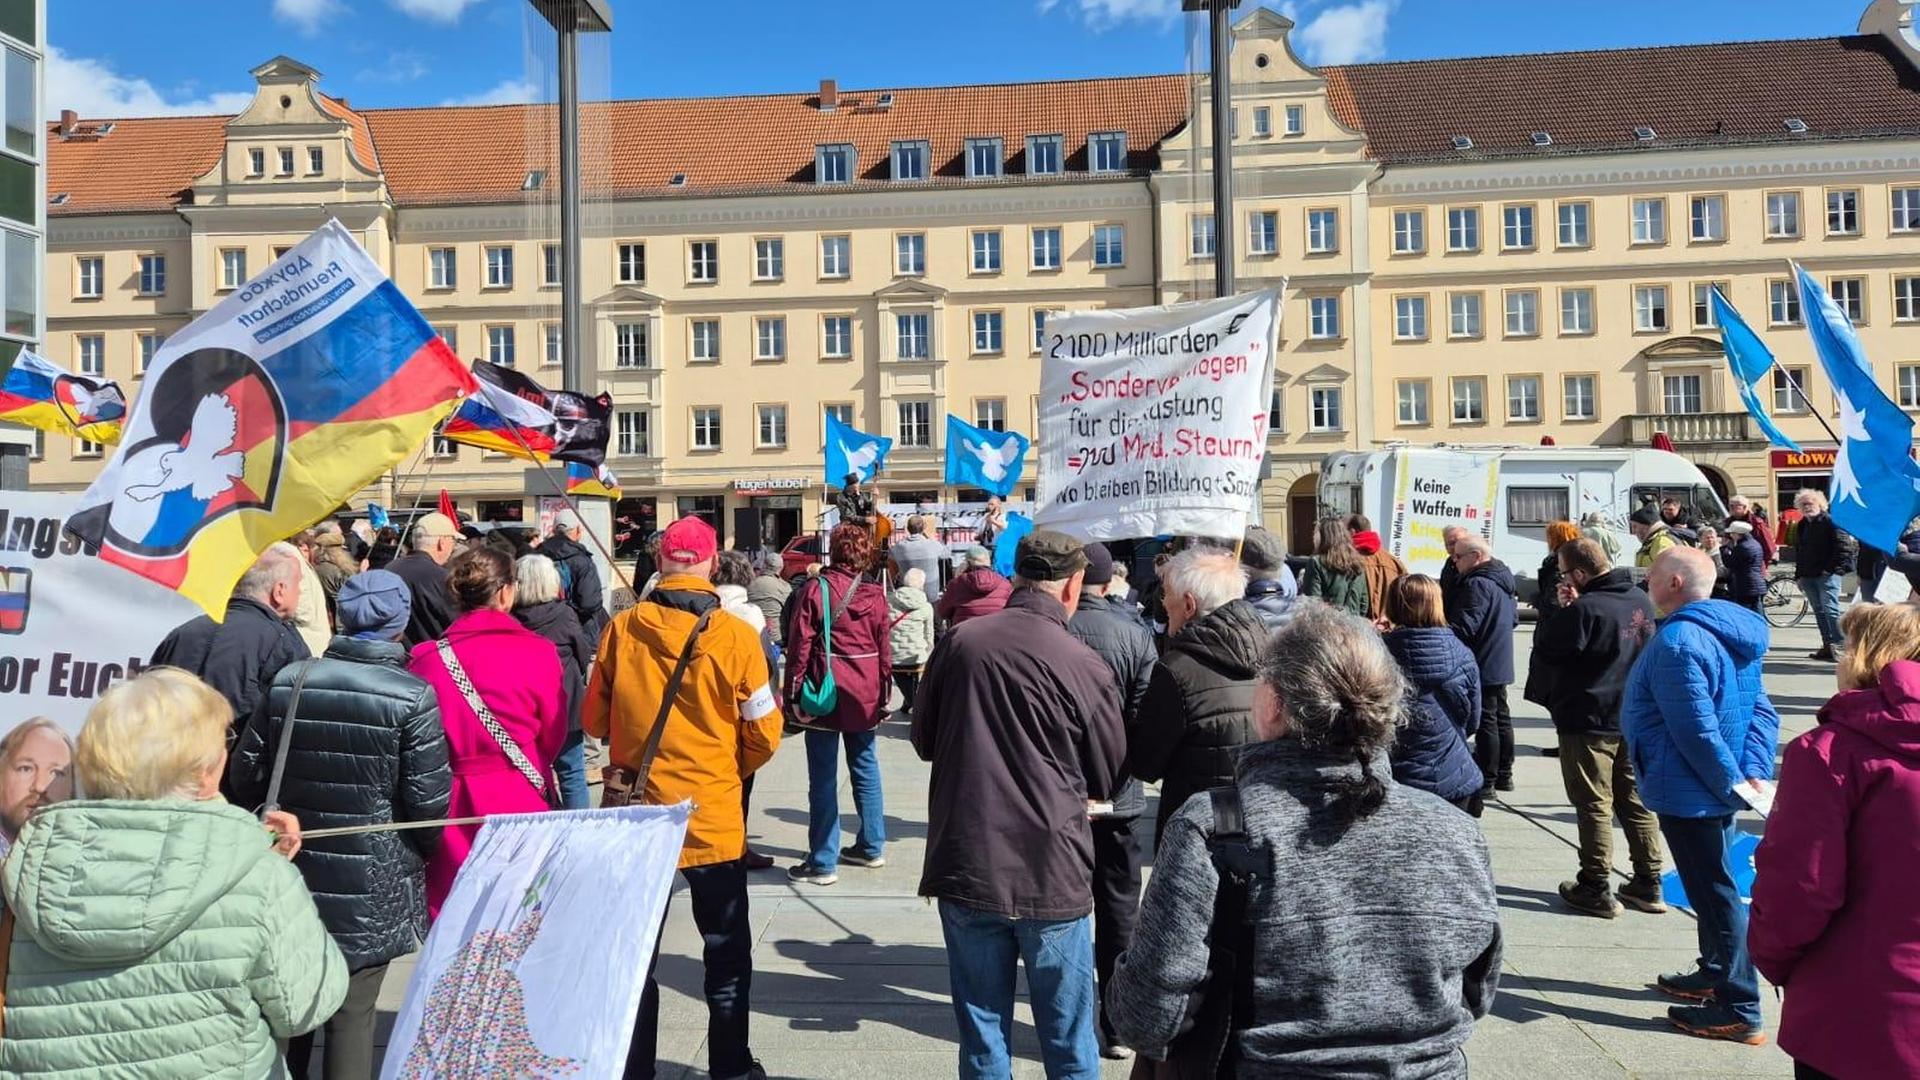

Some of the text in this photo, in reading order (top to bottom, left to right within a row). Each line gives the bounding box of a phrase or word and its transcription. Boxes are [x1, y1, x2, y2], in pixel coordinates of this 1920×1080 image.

[1114, 325, 1219, 356] Milliarden
[1068, 406, 1102, 438] für
[1123, 431, 1168, 463] Mrd.
[1084, 479, 1140, 502] bleiben
[1413, 477, 1451, 495] Keine
[1412, 499, 1478, 520] Waffen in
